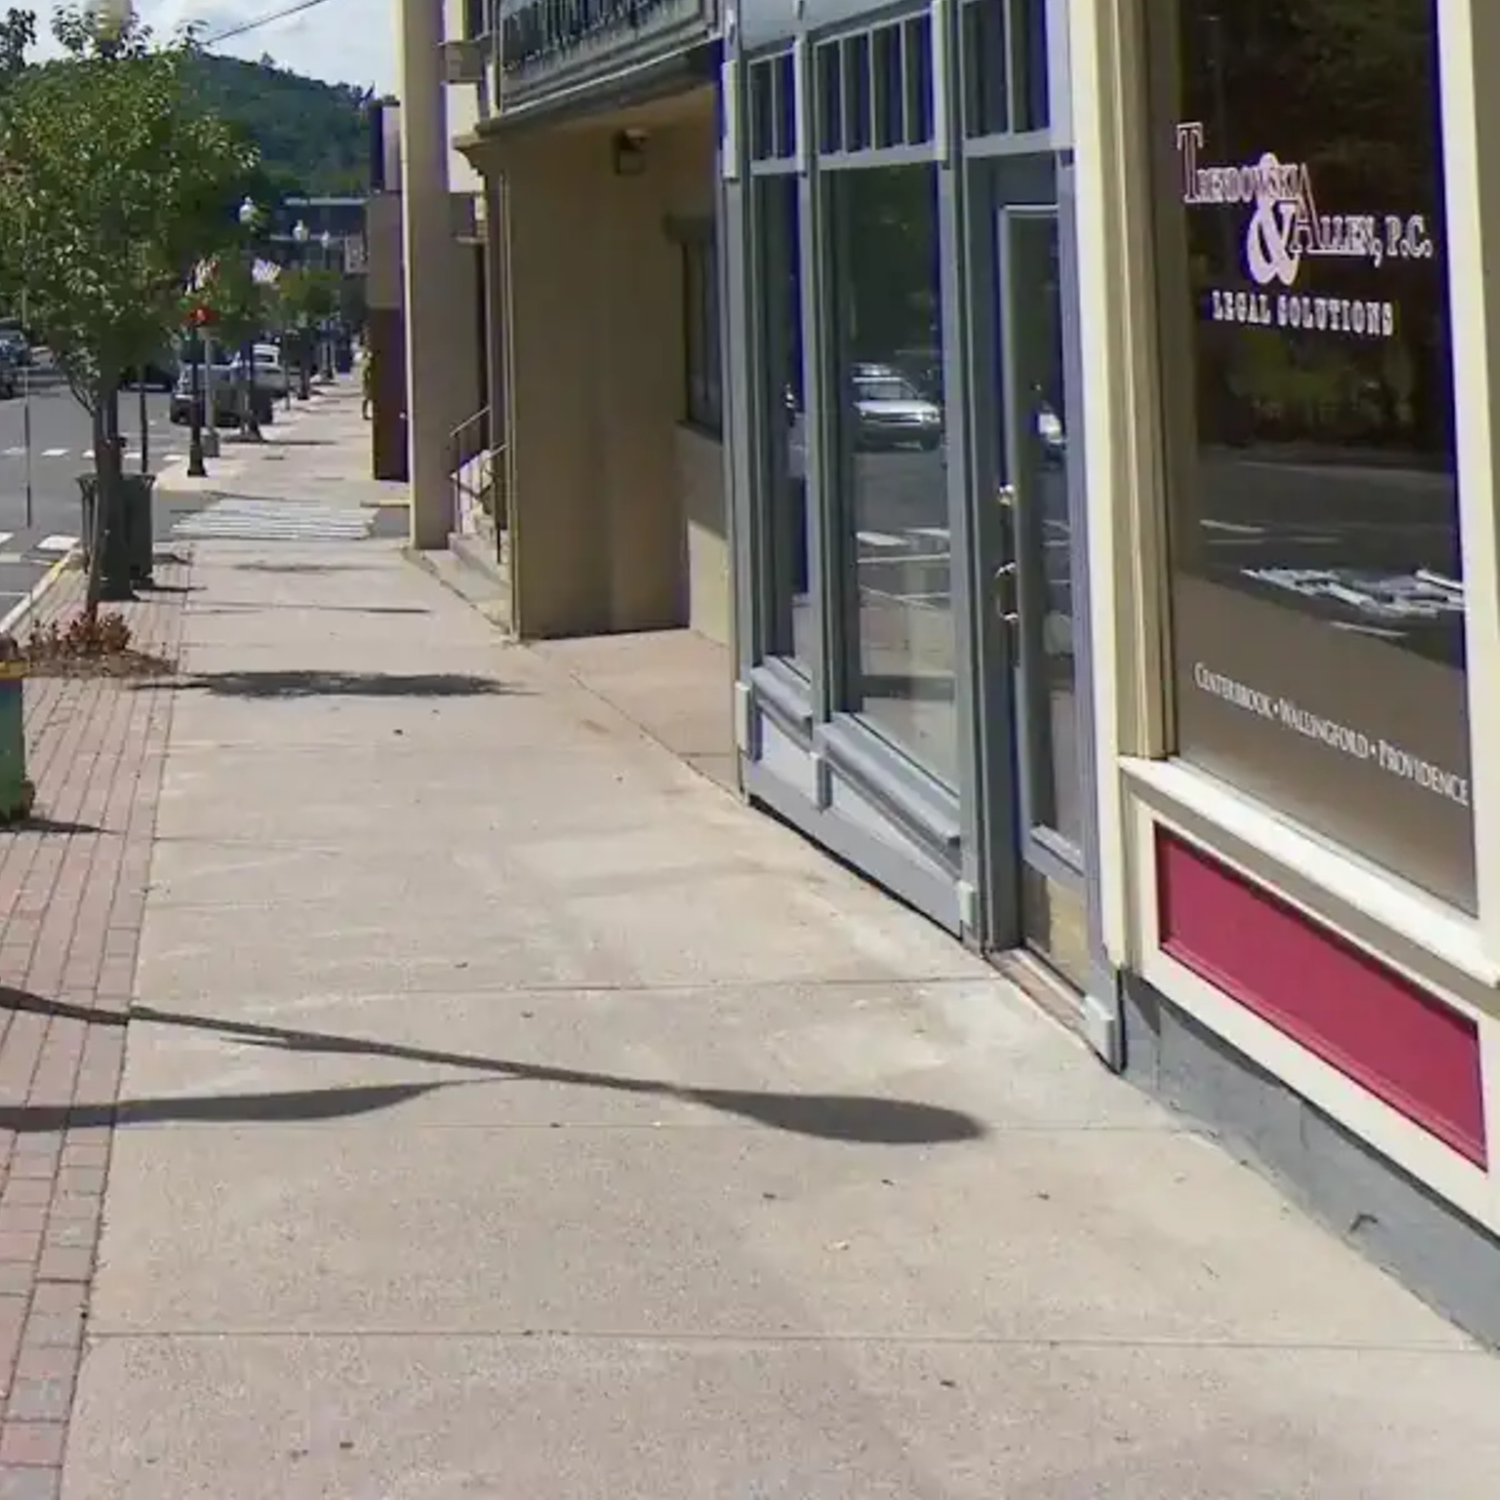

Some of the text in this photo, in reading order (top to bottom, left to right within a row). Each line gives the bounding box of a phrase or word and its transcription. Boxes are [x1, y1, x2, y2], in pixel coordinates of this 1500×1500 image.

[1247, 152, 1300, 286] &
[1385, 215, 1433, 258] P.C.
[1212, 290, 1393, 336] LEGAL SOLUTIONS
